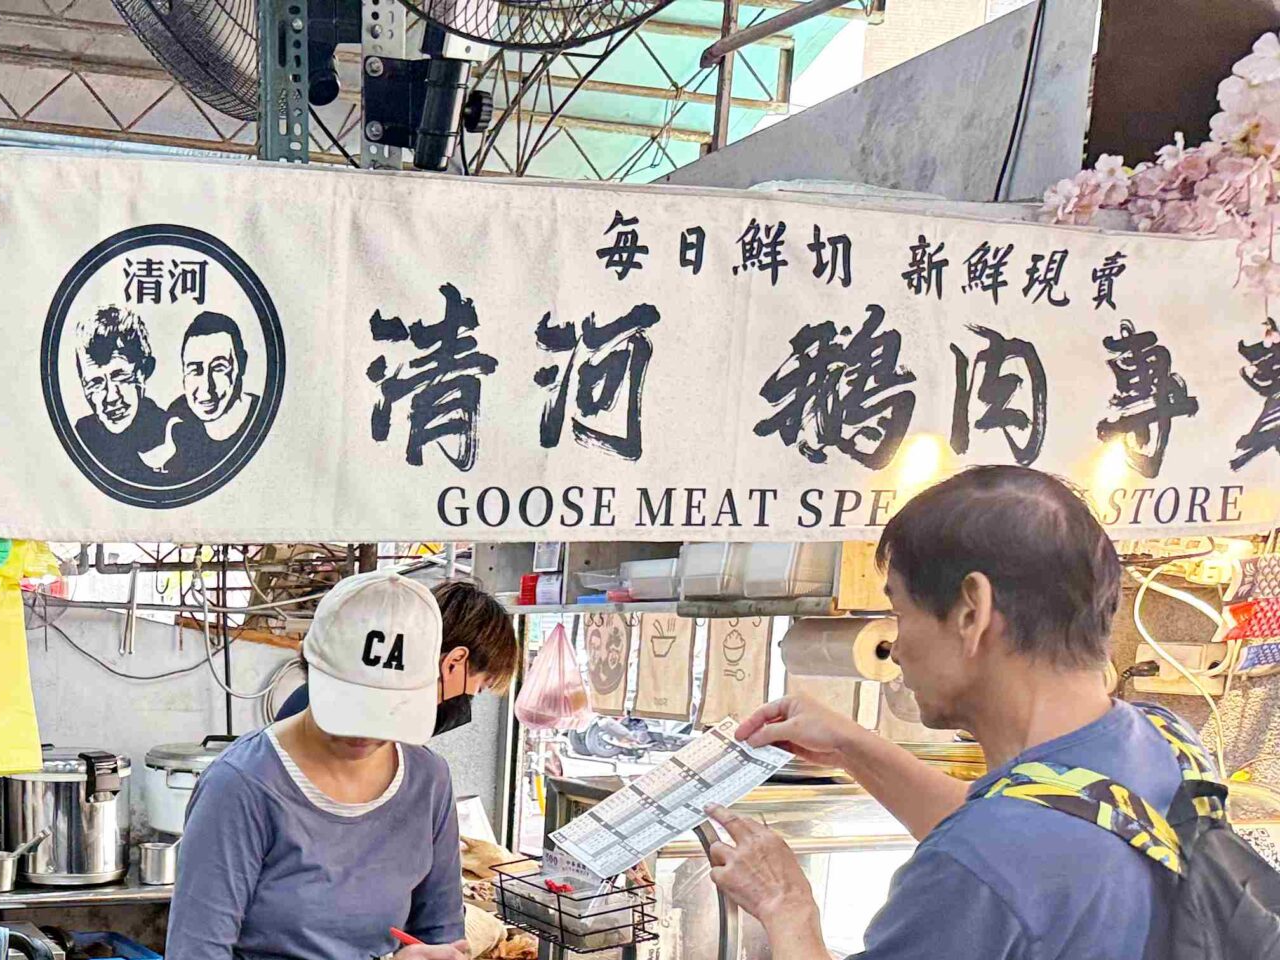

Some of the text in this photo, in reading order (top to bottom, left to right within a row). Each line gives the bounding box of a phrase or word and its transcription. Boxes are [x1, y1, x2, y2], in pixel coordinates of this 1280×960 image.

[122, 257, 210, 305] 清河
[596, 210, 1128, 311] 每日鮮切 新鮮現賣
[366, 281, 661, 472] 清河
[437, 485, 617, 528] GOOSE
[635, 487, 778, 528] MEAT
[1100, 485, 1244, 528] STORE
[361, 629, 405, 671] CA
